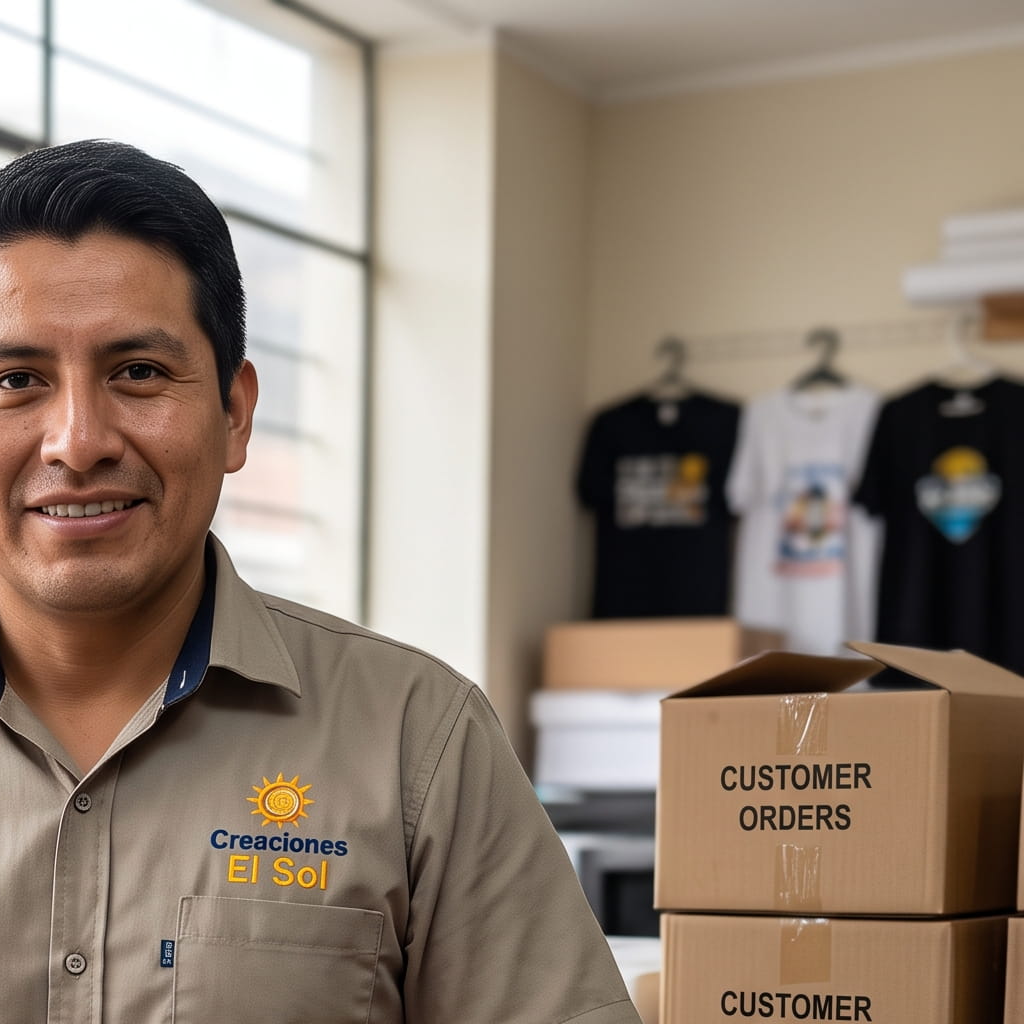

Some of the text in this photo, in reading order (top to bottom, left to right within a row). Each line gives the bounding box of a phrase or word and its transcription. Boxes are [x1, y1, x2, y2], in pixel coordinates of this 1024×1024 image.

[720, 763, 872, 791] CUSTOMER
[739, 804, 851, 831] ORDERS
[210, 829, 348, 857] Creaciones
[227, 855, 329, 890] El Sol
[721, 991, 872, 1022] CUSTOMER
